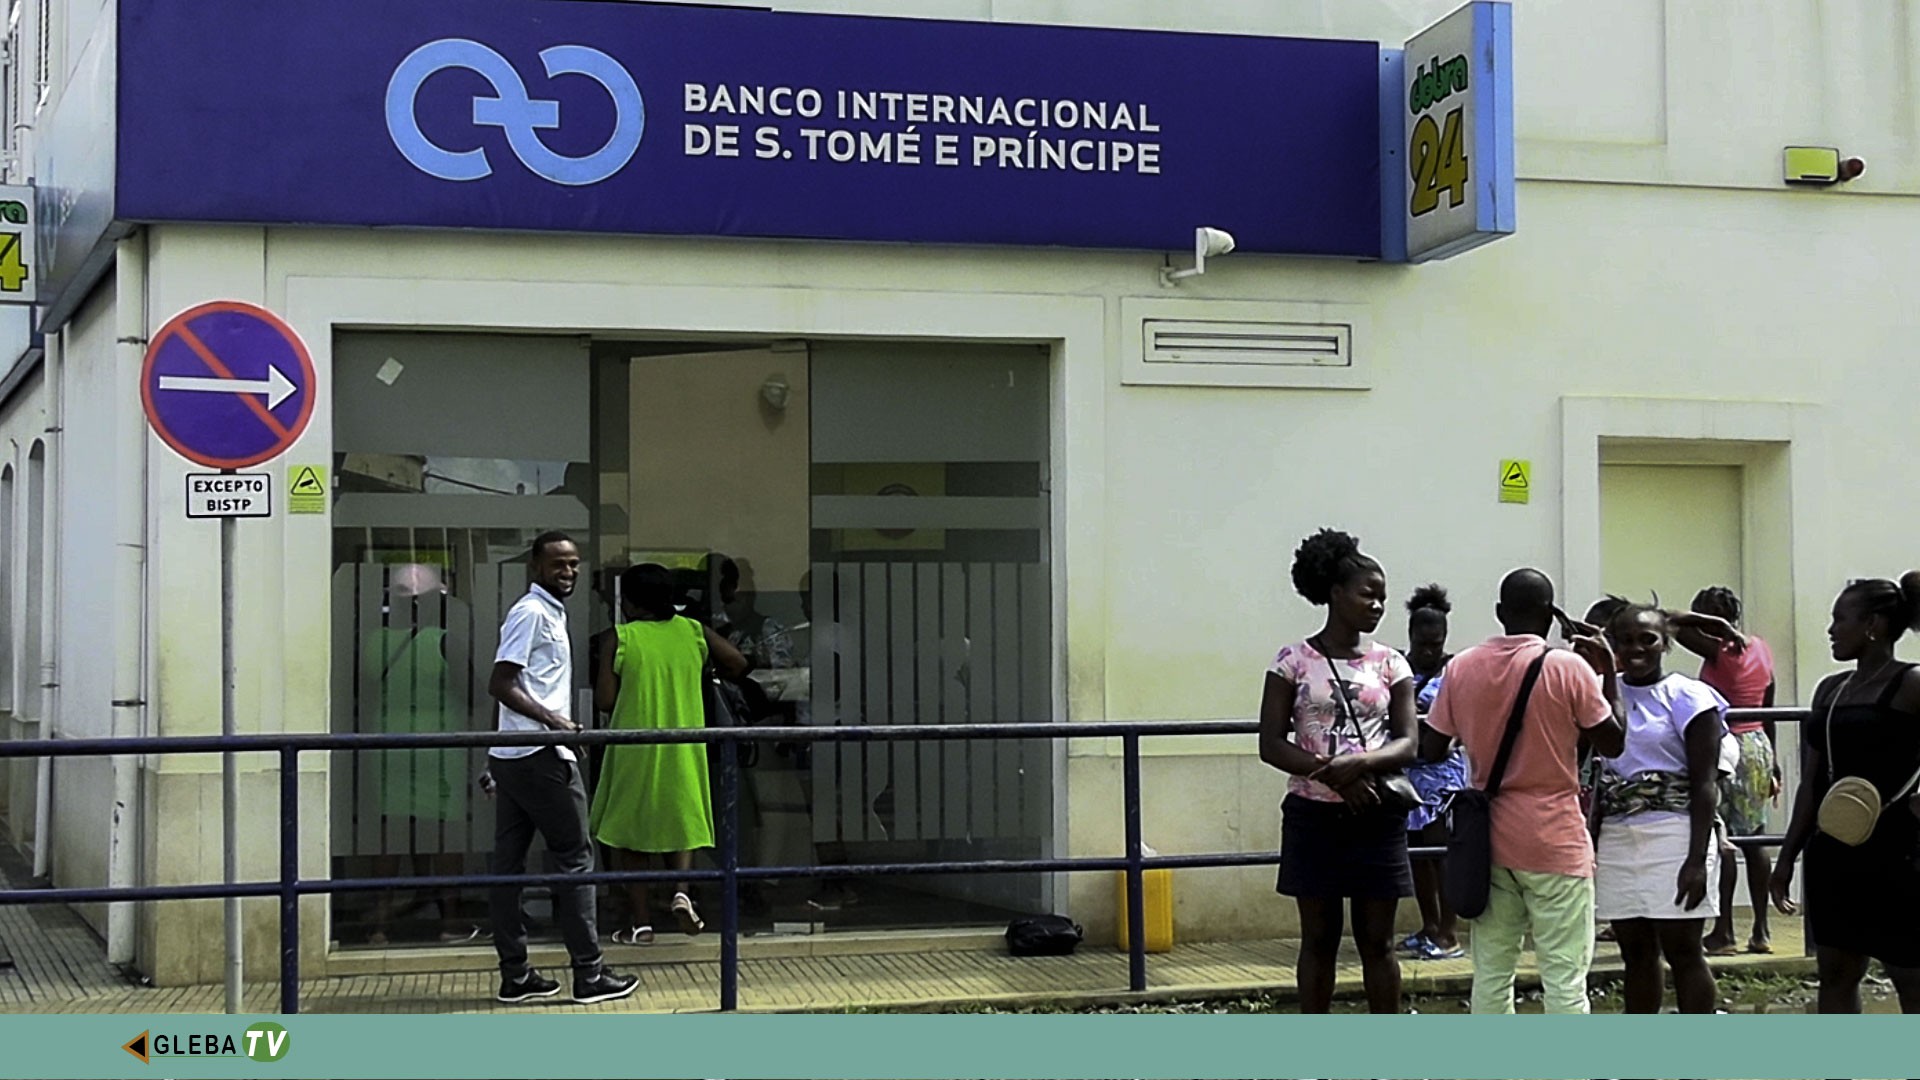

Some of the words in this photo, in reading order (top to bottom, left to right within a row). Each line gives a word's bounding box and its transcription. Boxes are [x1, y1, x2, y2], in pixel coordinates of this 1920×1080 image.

[684, 83, 822, 118] BANCO
[838, 90, 1160, 132] INTERNACIONAL
[684, 124, 740, 157] DE
[755, 126, 792, 160] S.
[800, 125, 921, 164] TOMÉ
[935, 134, 959, 166] E
[973, 130, 1160, 174] PRÍNCIPE
[1409, 104, 1468, 218] 24
[194, 480, 263, 493] EXCEPTO
[207, 499, 252, 511] BISTP
